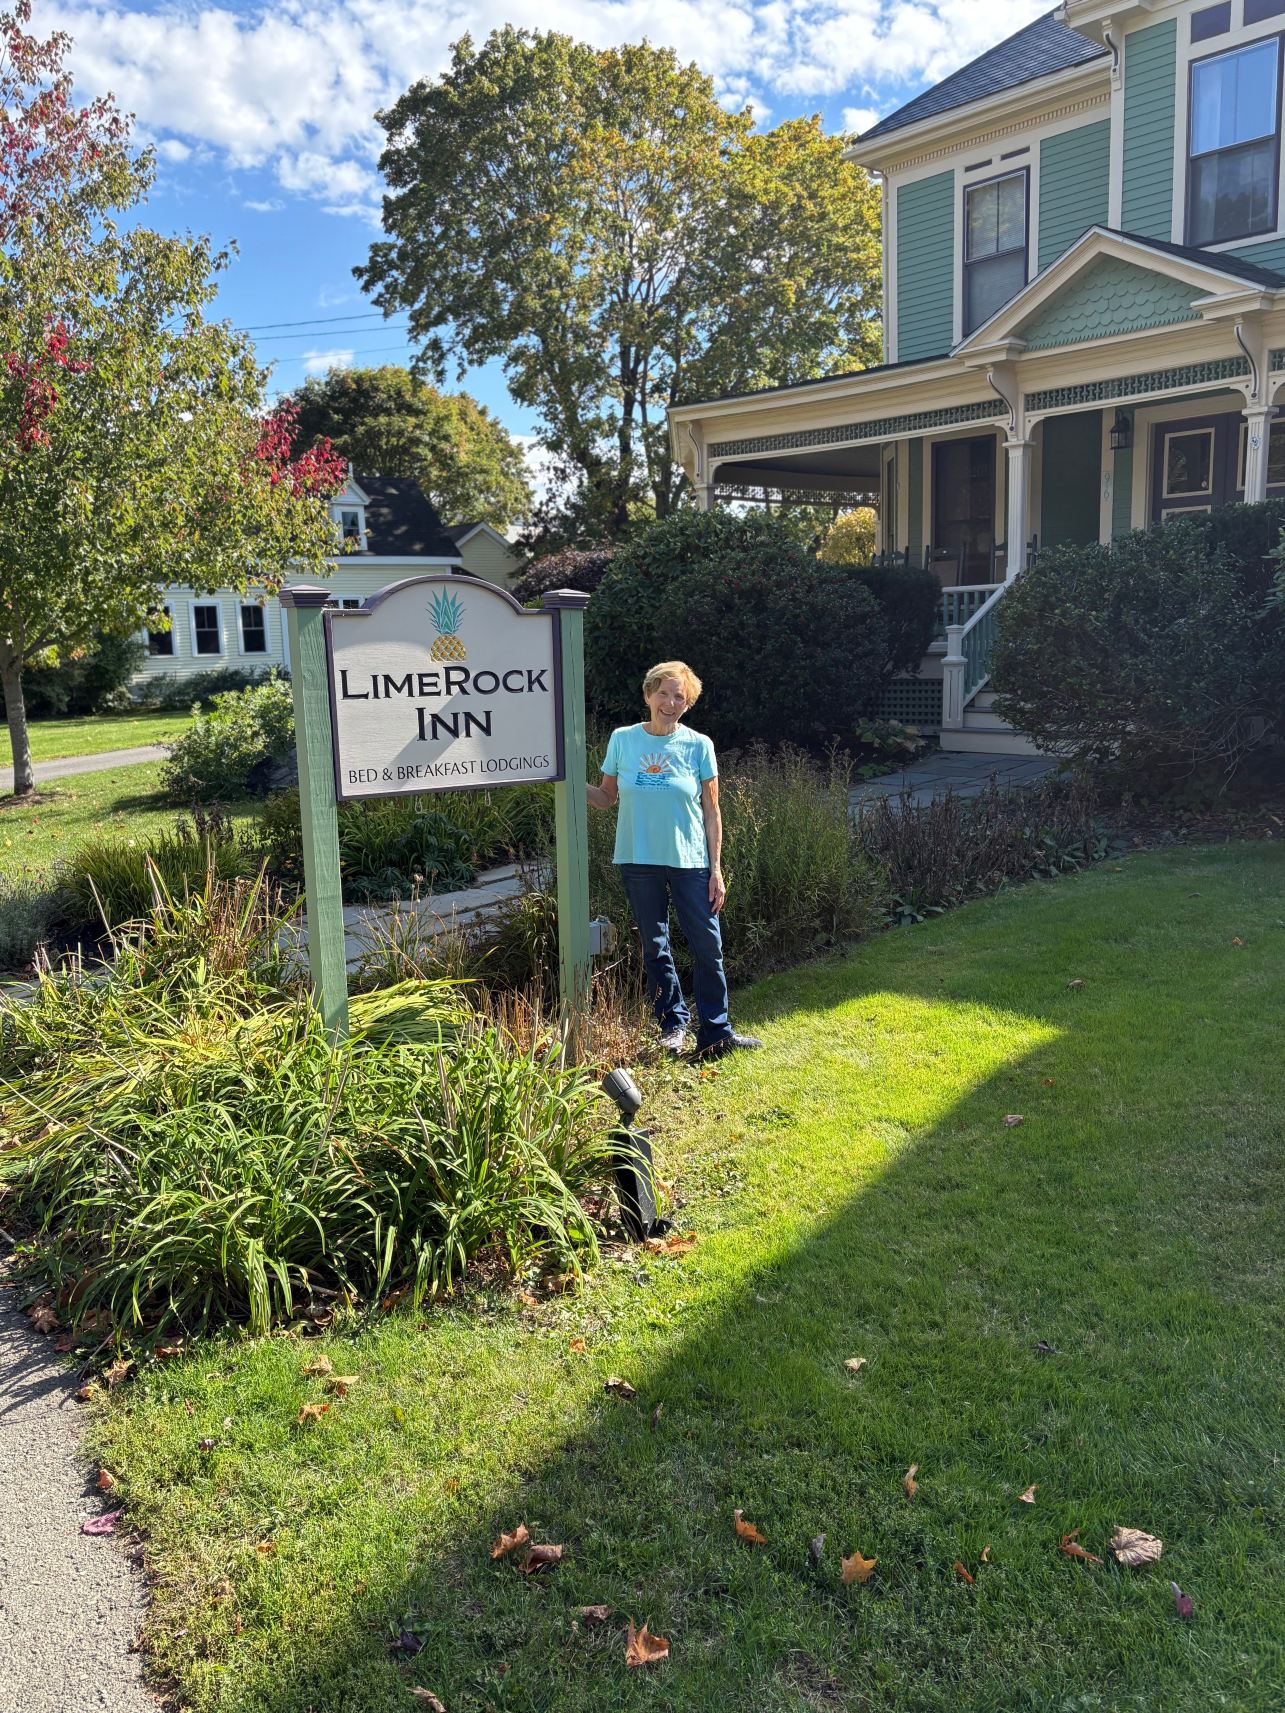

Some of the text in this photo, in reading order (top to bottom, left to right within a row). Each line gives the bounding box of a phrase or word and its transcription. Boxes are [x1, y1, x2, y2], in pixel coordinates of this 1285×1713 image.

[349, 754, 550, 784] BED & BREAKFAST LODGINGS
